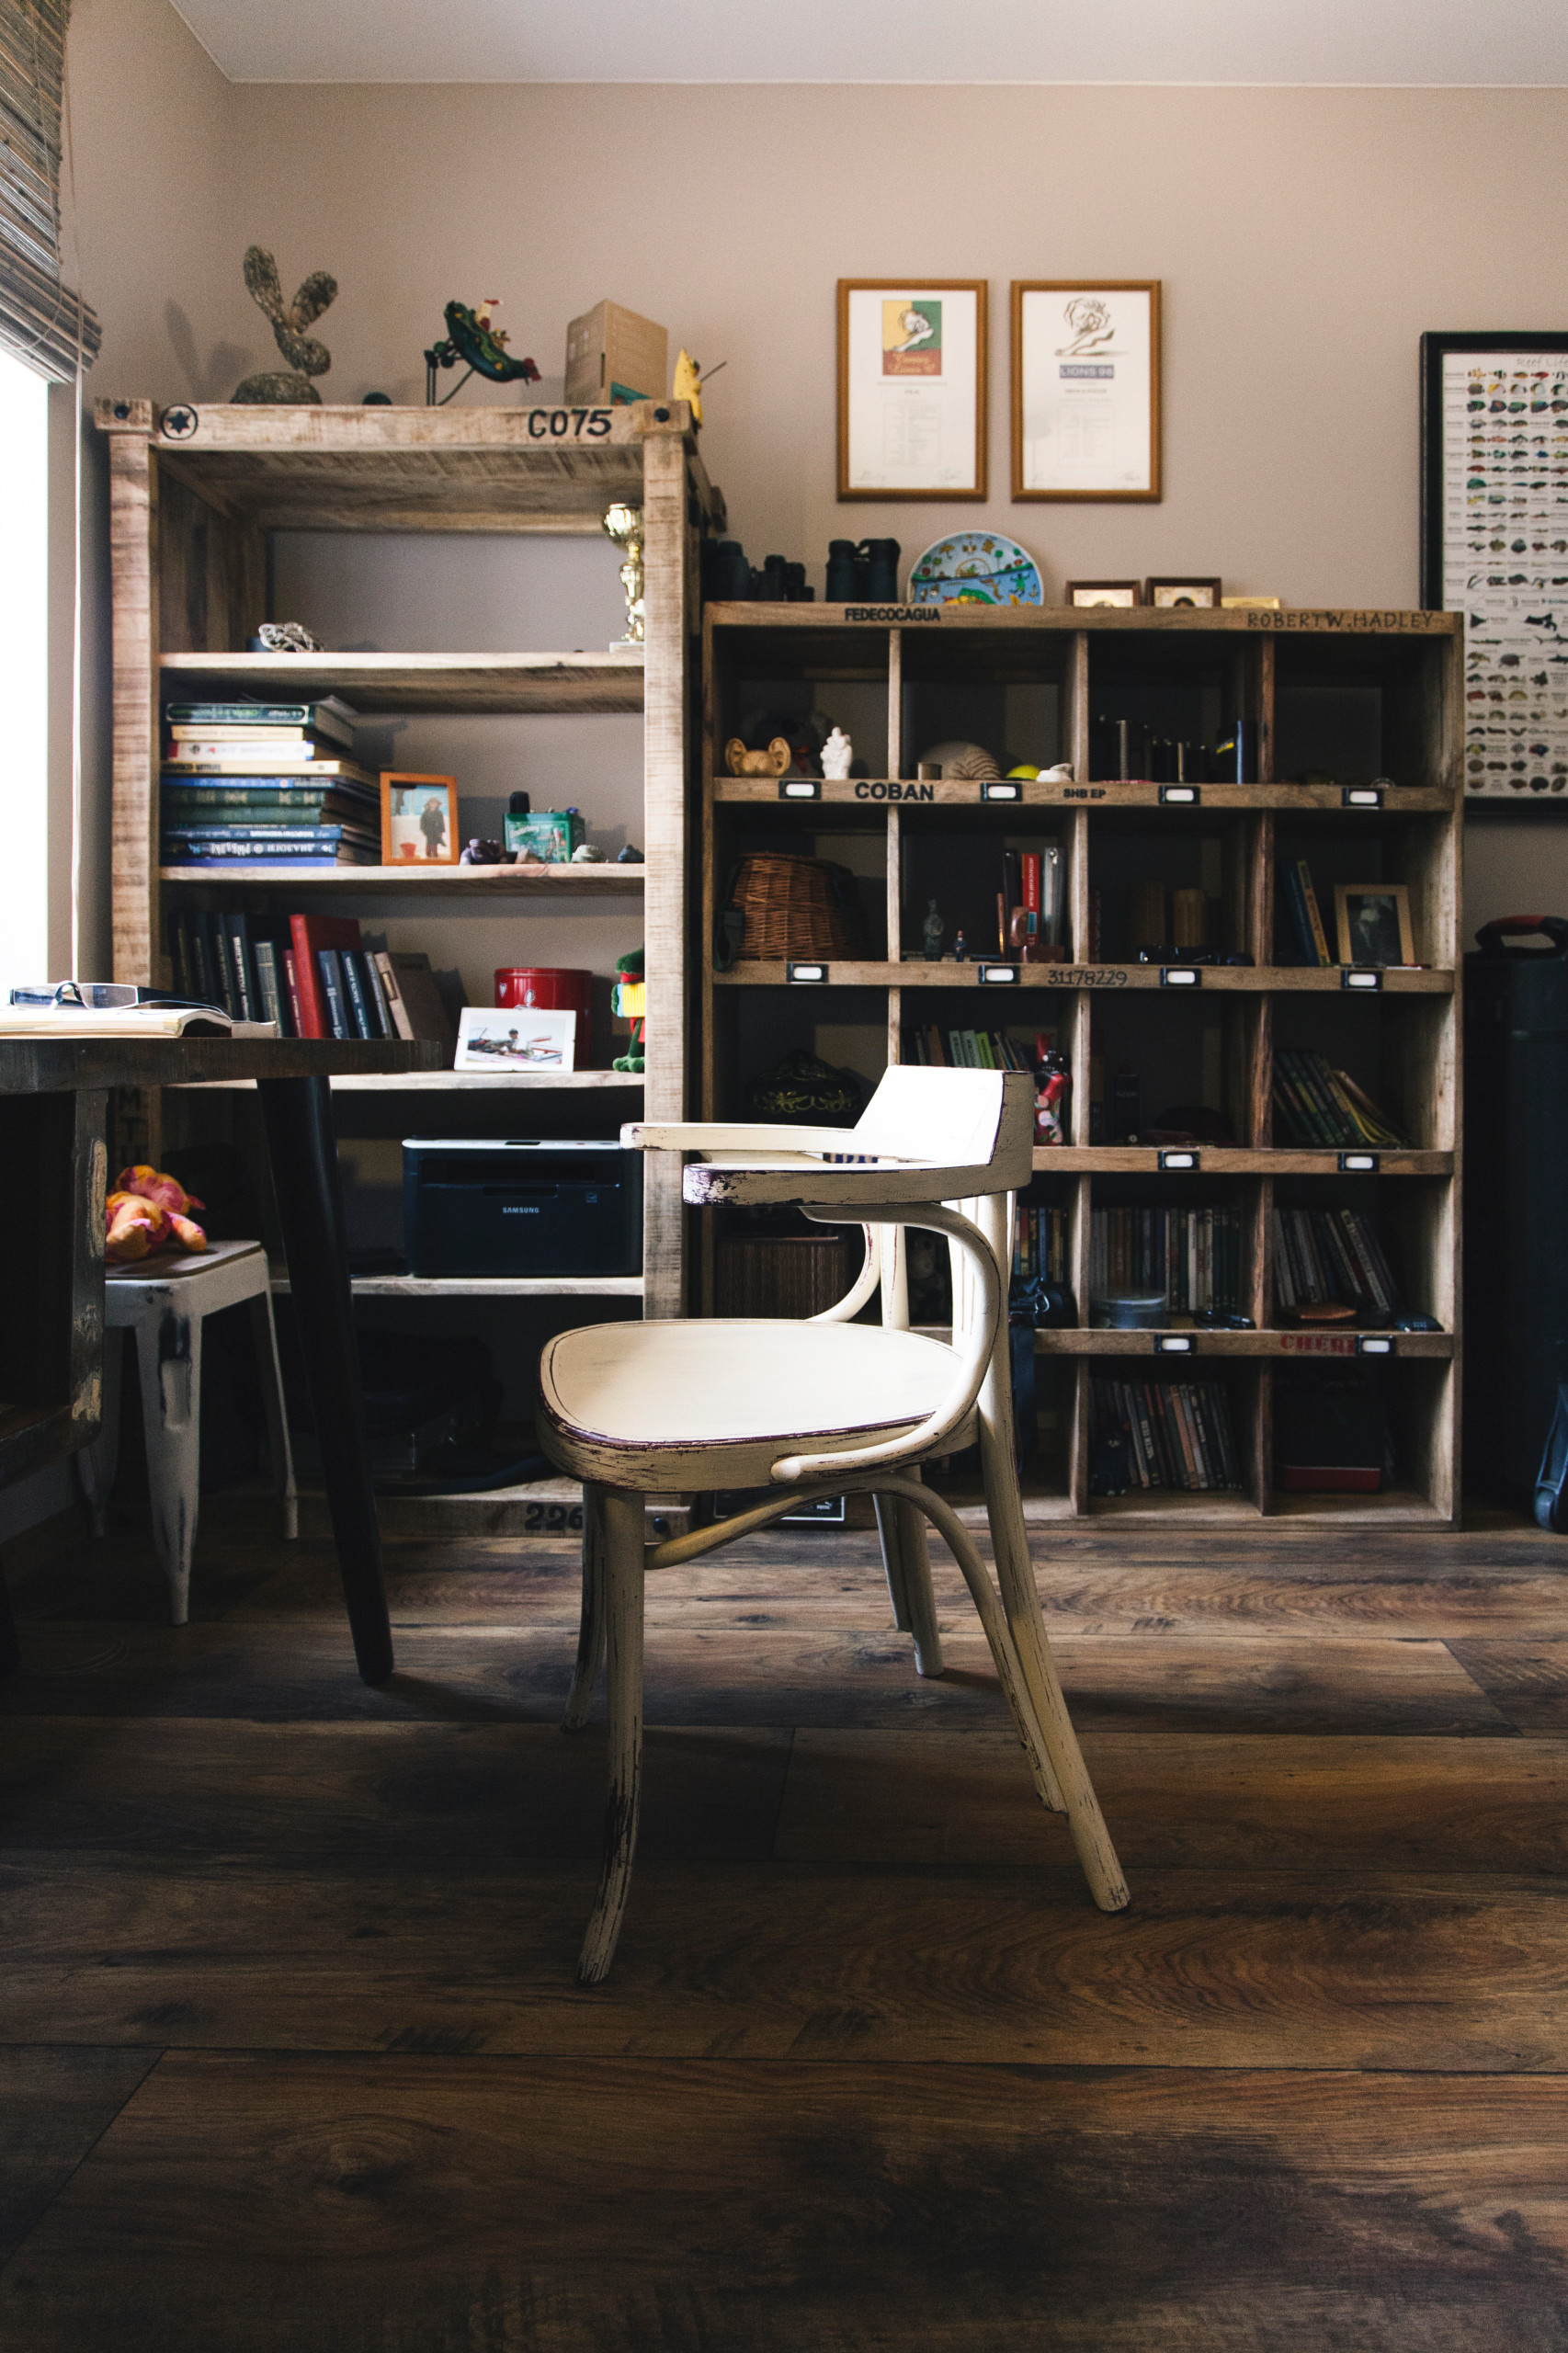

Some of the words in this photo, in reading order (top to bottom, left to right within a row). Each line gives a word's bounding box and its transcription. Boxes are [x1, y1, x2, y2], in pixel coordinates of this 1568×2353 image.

[845, 608, 940, 621] FEDECOCAGUA
[855, 781, 934, 801] COBAN
[1048, 970, 1127, 986] 31178229
[524, 1502, 584, 1531] 226
